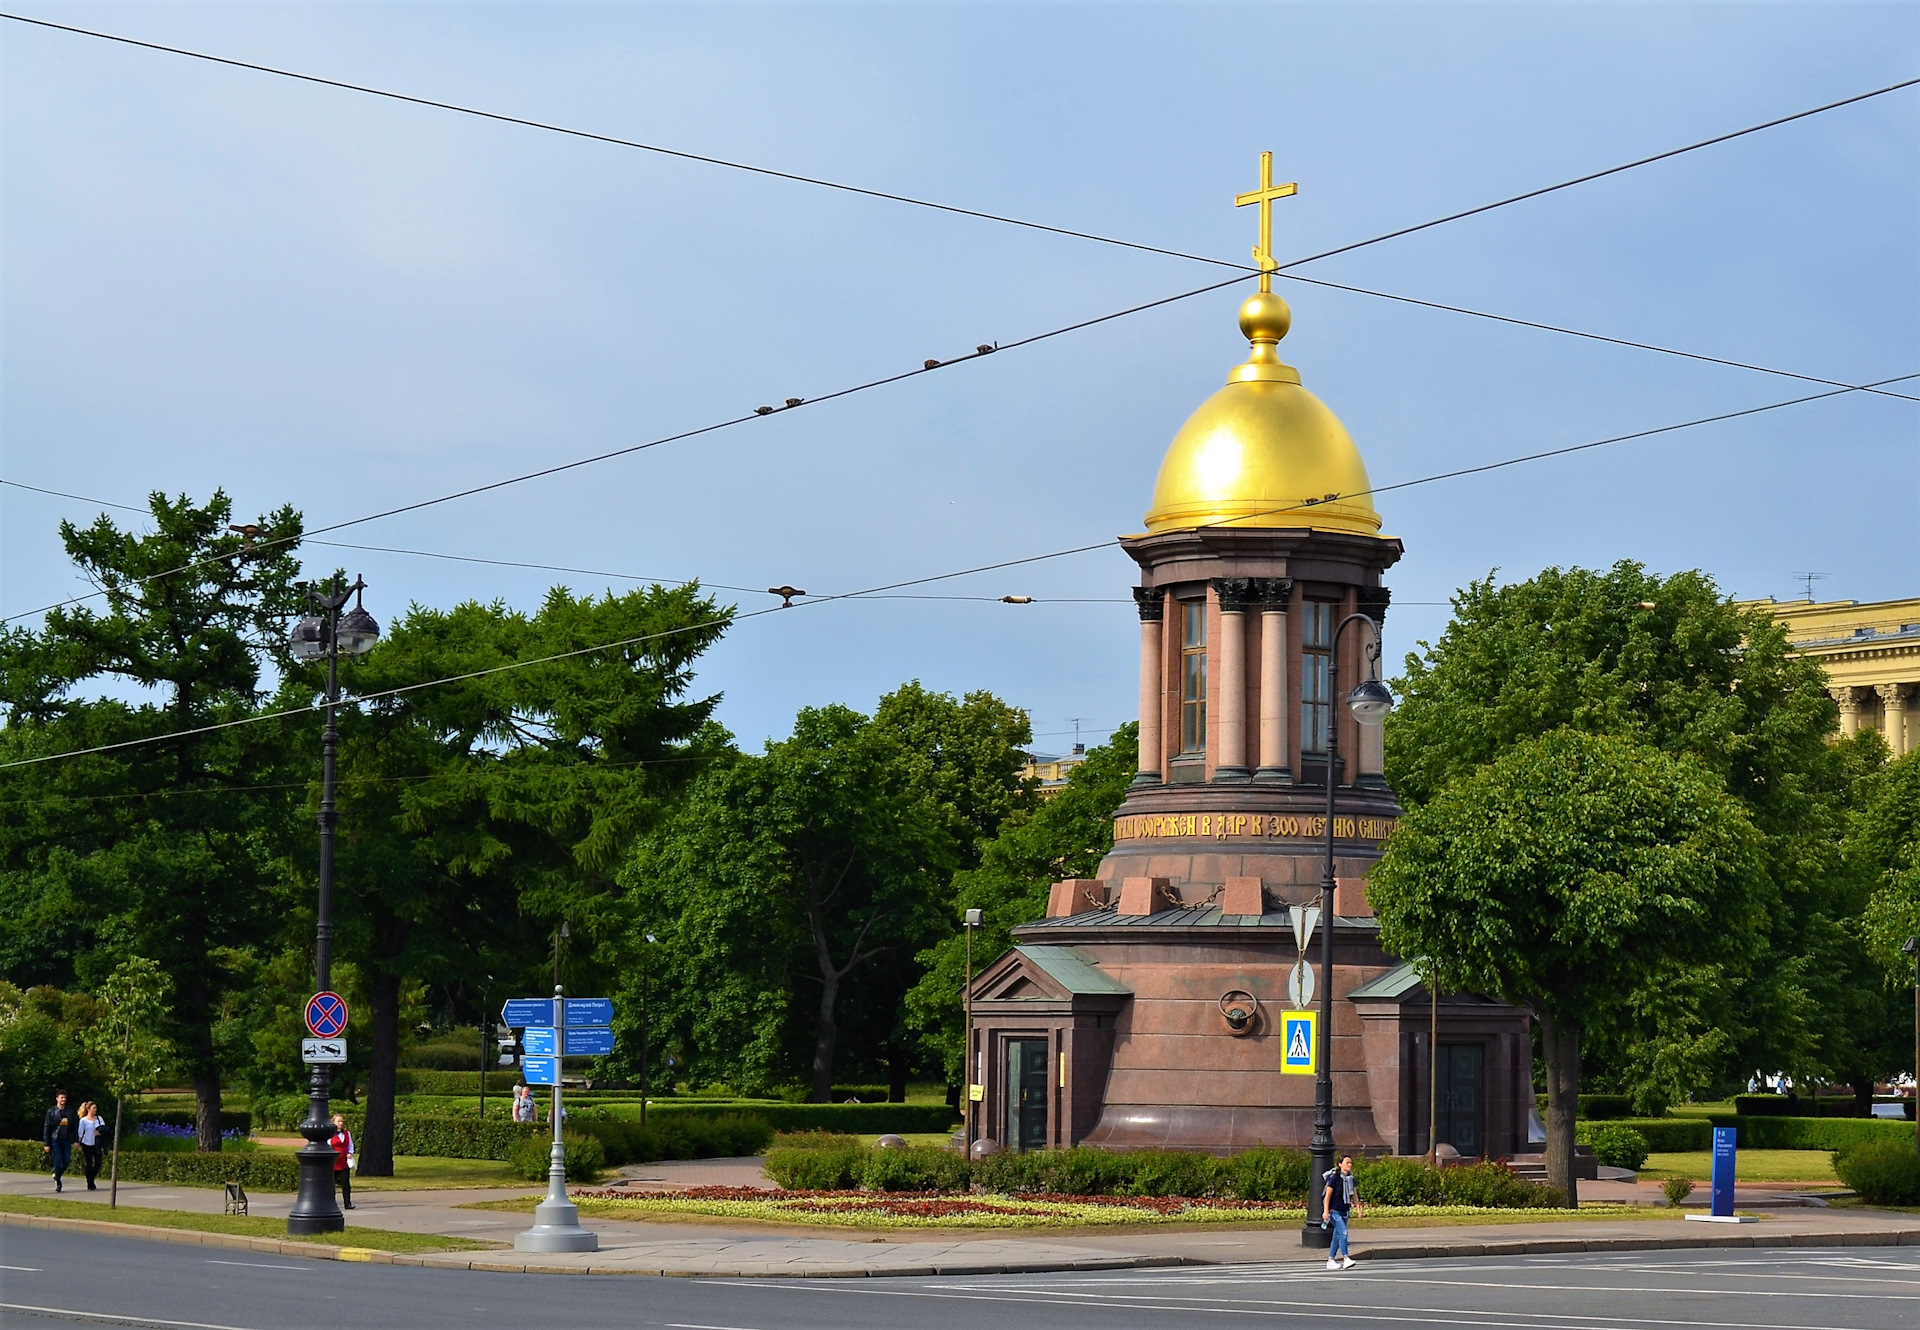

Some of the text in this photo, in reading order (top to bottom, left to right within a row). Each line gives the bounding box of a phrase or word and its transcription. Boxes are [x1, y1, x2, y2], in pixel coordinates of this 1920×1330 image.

[1201, 815, 1211, 836] В
[1215, 815, 1246, 840] ДАР
[1251, 815, 1262, 836] К
[1269, 815, 1299, 836] 300
